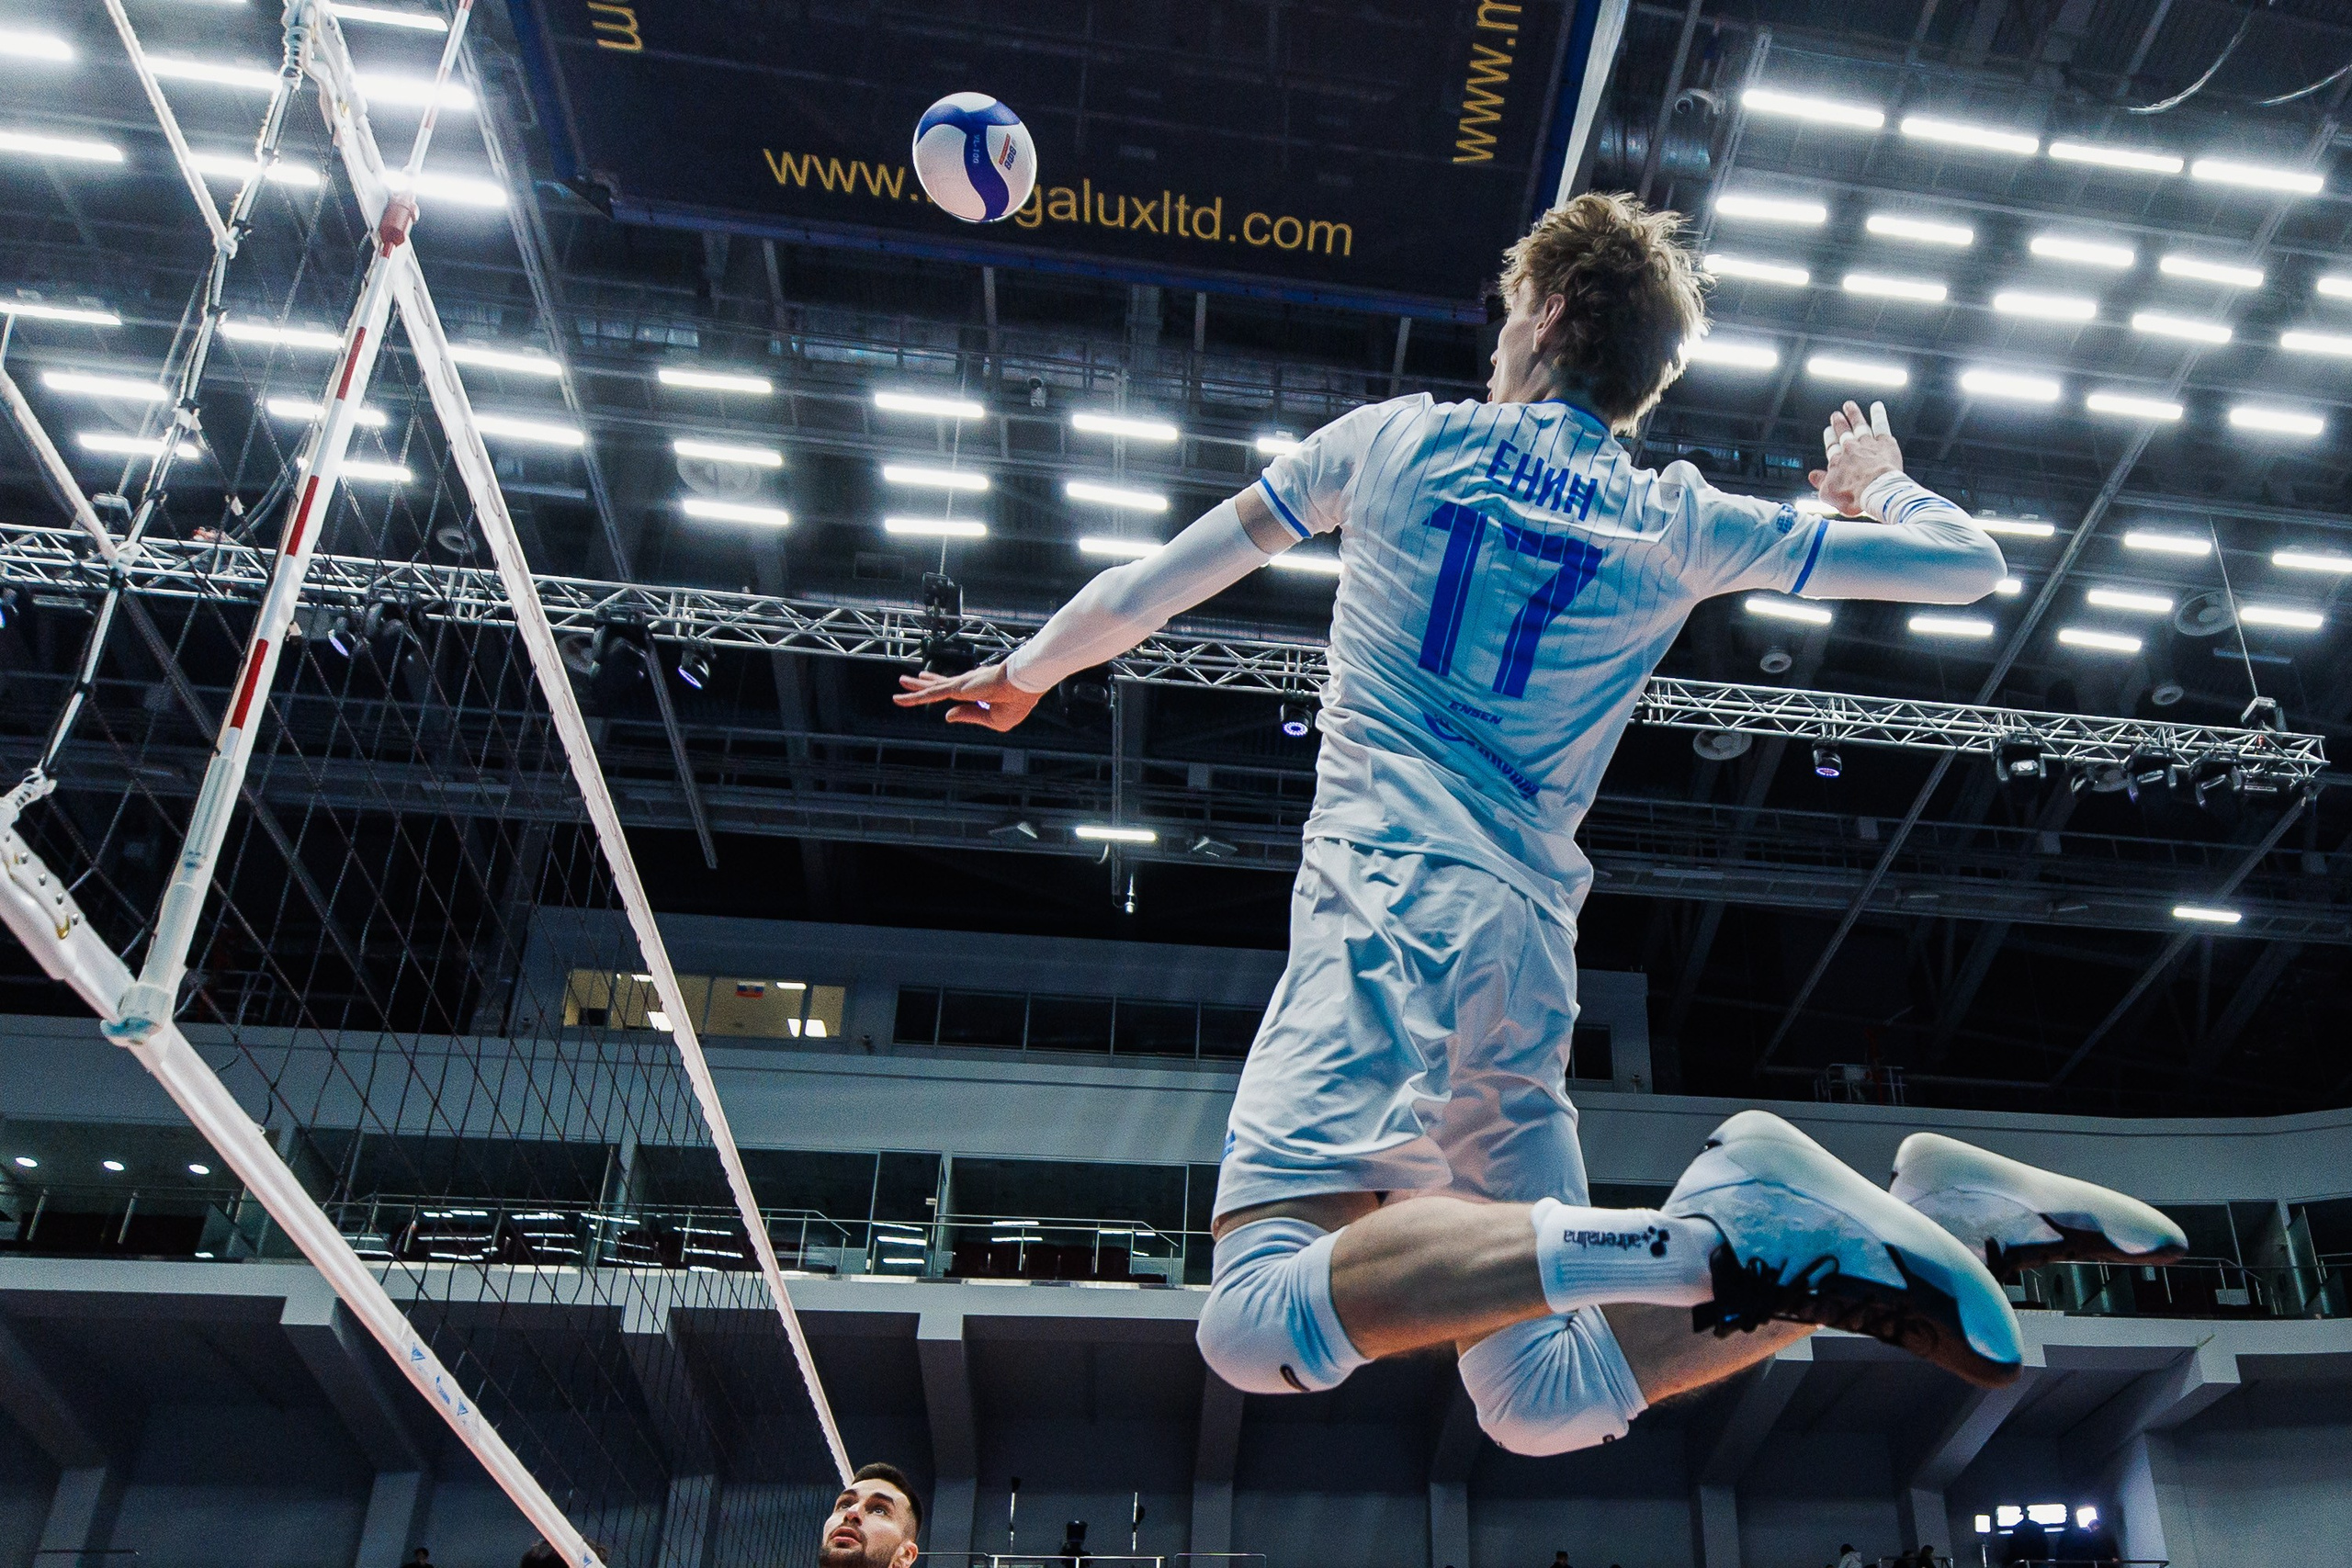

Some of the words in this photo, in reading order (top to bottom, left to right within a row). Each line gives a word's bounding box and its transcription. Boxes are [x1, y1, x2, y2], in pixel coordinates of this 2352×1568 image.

[763, 147, 1353, 256] www.galuxltd.com
[1485, 438, 1599, 522] ЕНИН
[1418, 501, 1603, 699] 17
